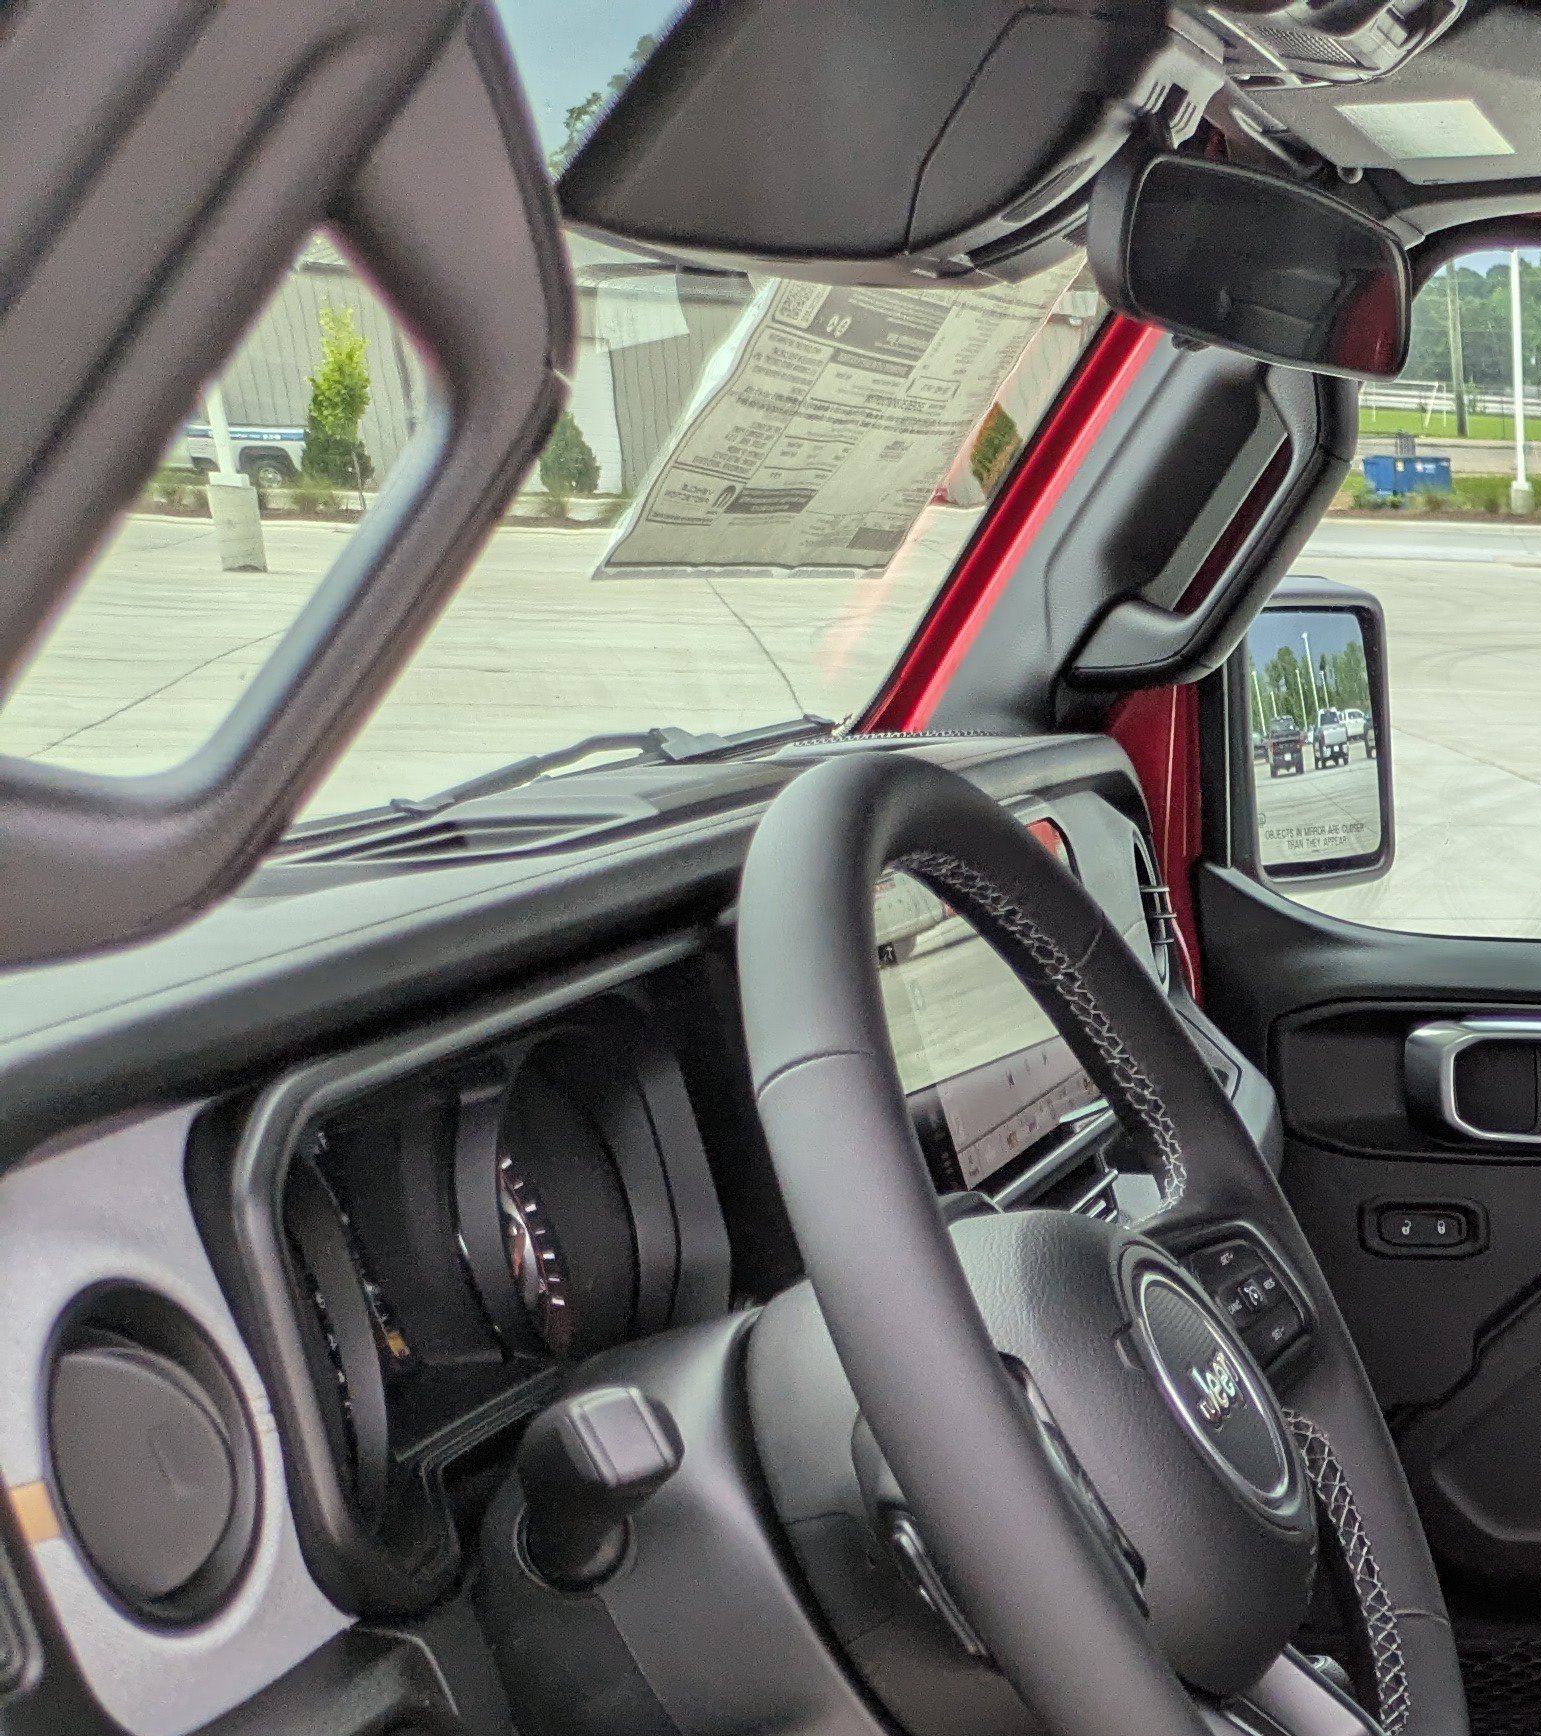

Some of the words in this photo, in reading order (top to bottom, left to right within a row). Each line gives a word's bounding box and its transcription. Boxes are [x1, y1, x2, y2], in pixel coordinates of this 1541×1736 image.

[1265, 828, 1294, 840] OBJECTS
[1304, 825, 1326, 836] MIRROR
[1327, 824, 1340, 834] ARE
[1341, 822, 1365, 834] CLOSER
[1287, 838, 1304, 850] THAN
[1306, 837, 1321, 847] THEY
